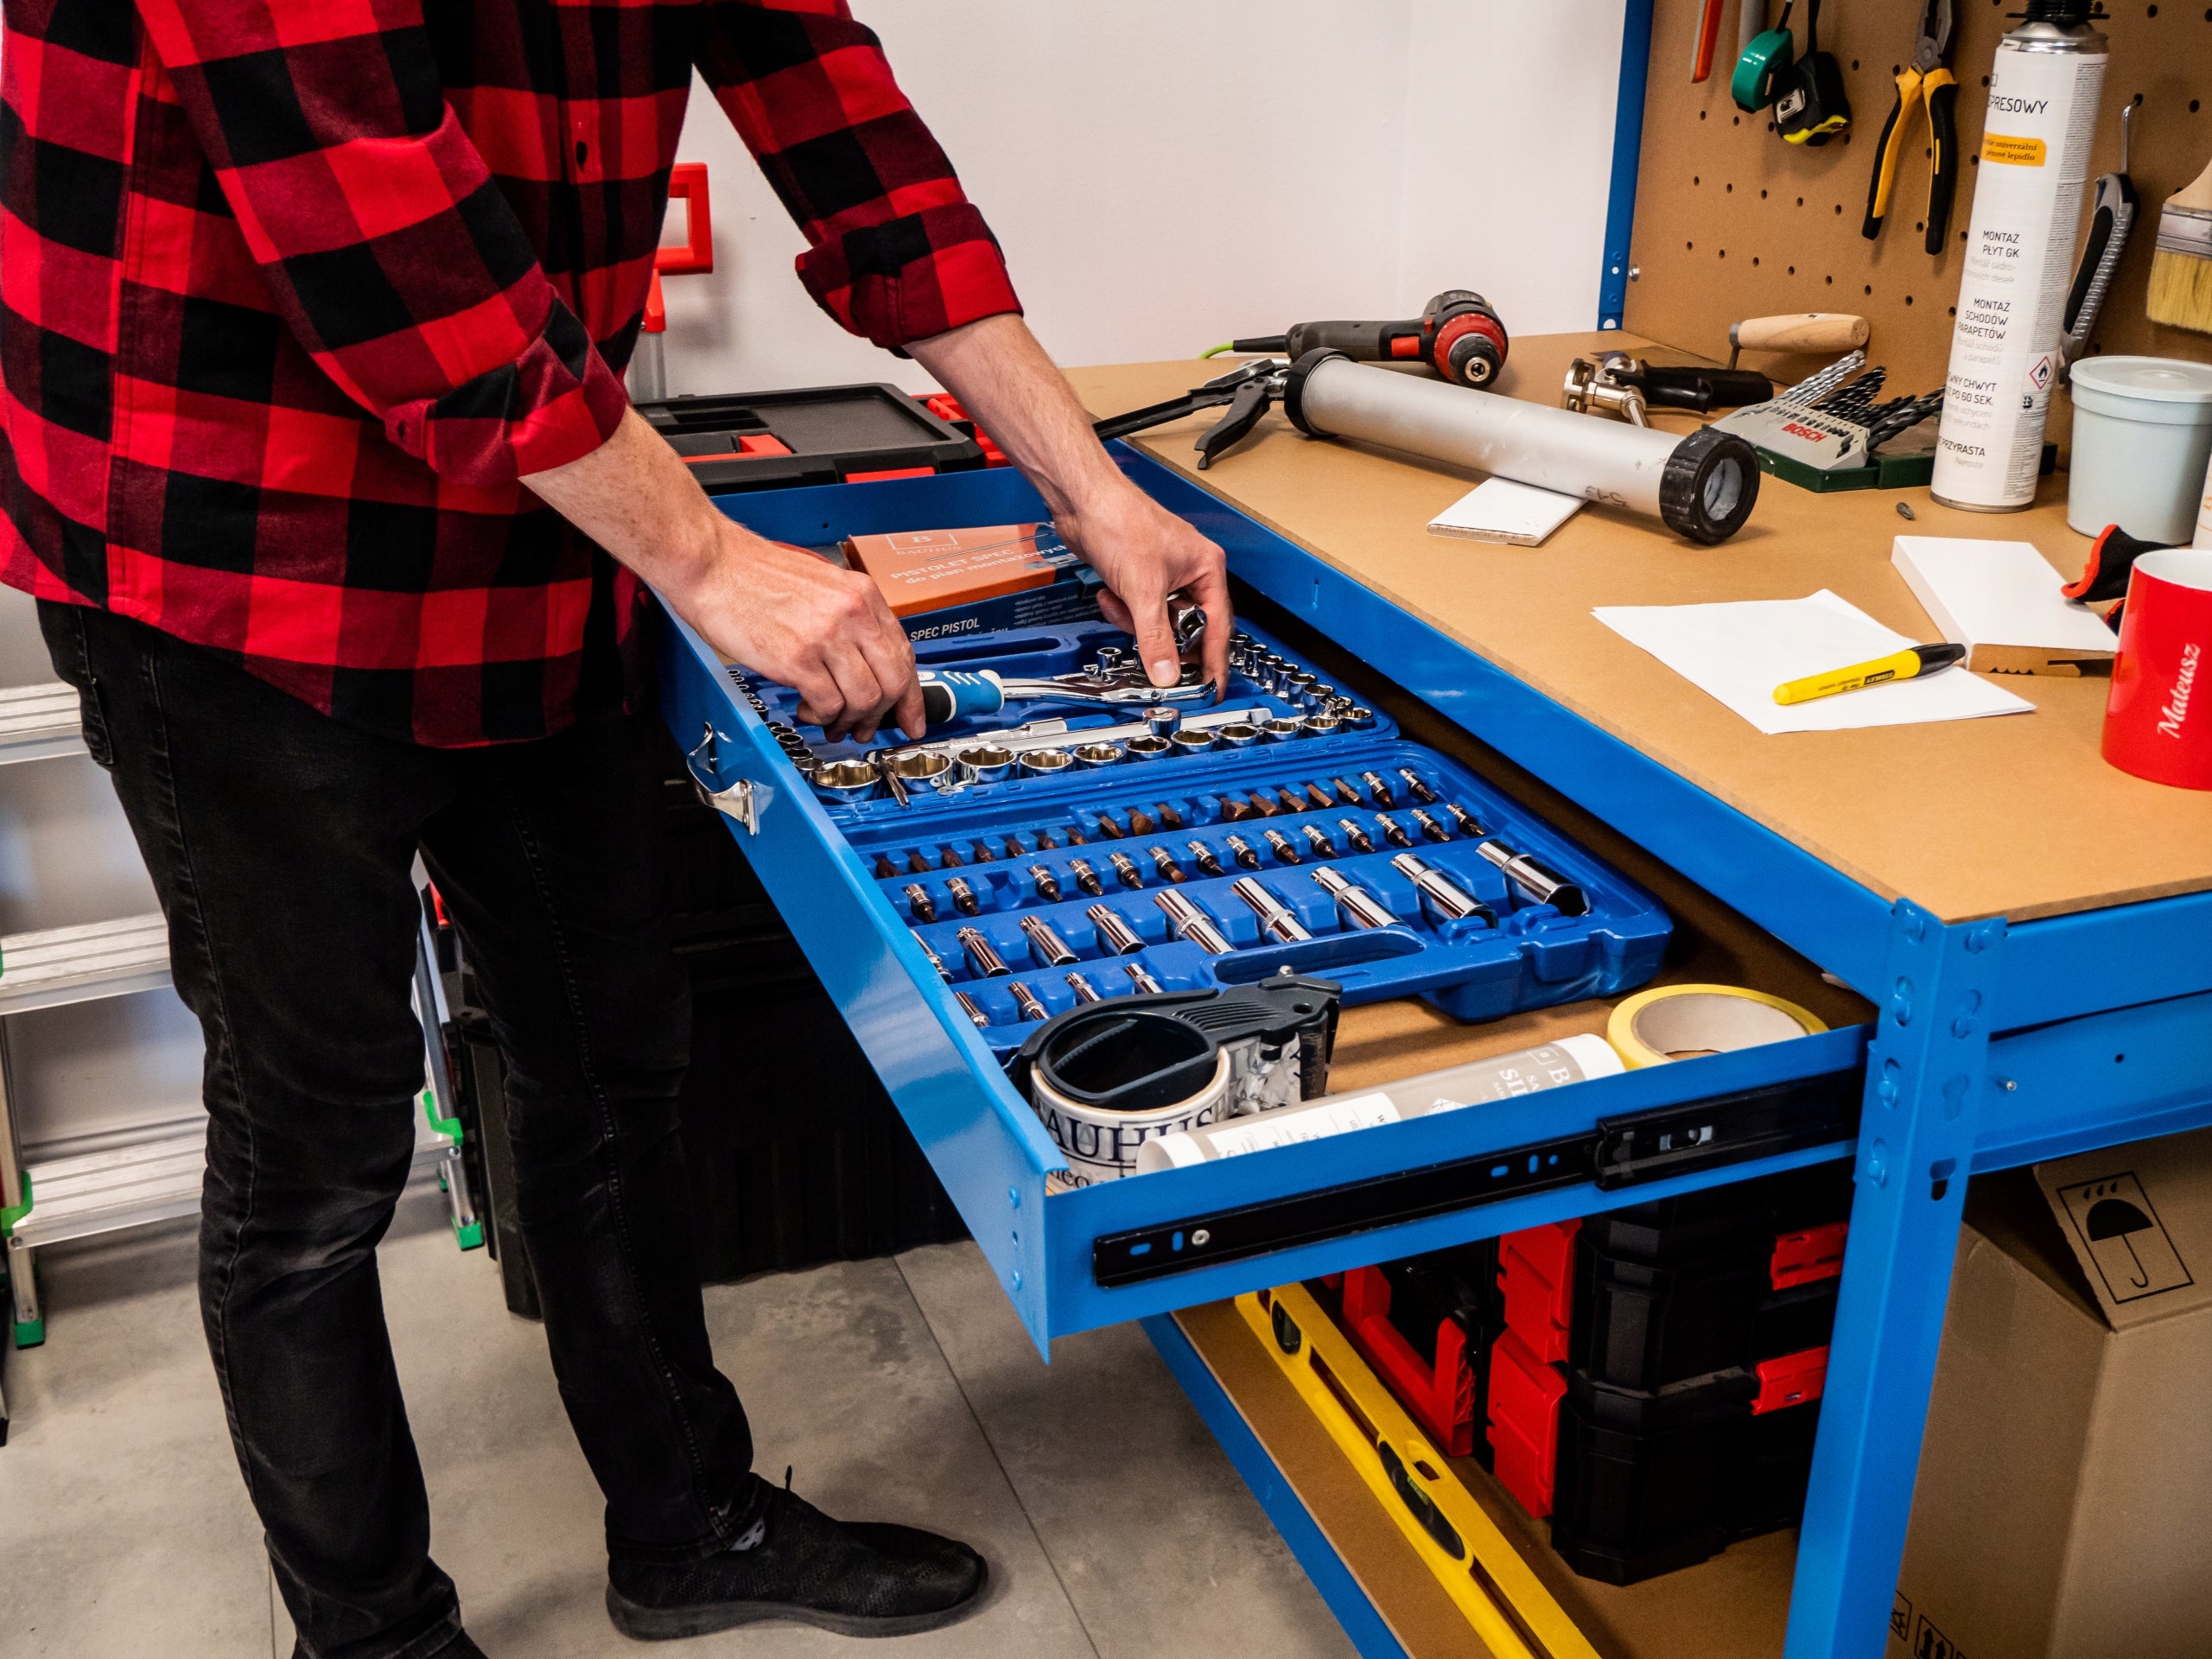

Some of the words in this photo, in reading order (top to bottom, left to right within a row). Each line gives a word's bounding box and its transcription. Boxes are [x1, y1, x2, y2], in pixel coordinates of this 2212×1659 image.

[2007, 151, 2036, 162] lepidlo
[1983, 245, 2004, 257] PŁYT
[2005, 248, 2020, 258] GK
[1965, 310, 2009, 326] SCHODÓW
[1964, 378, 1997, 392] CHWYT
[1952, 391, 1961, 400] PO
[1961, 393, 1972, 403] 60
[1782, 423, 1827, 442] BOSCH
[1942, 438, 1986, 457] PRZYRASTA
[889, 559, 968, 580] PISTOLET
[973, 549, 1015, 562] SPEC
[905, 575, 927, 585] do
[933, 568, 965, 581] pian
[910, 626, 940, 642] SPEC
[941, 617, 980, 637] PISTOL
[2158, 644, 2201, 739] Mateusz
[1548, 1066, 1571, 1087] B
